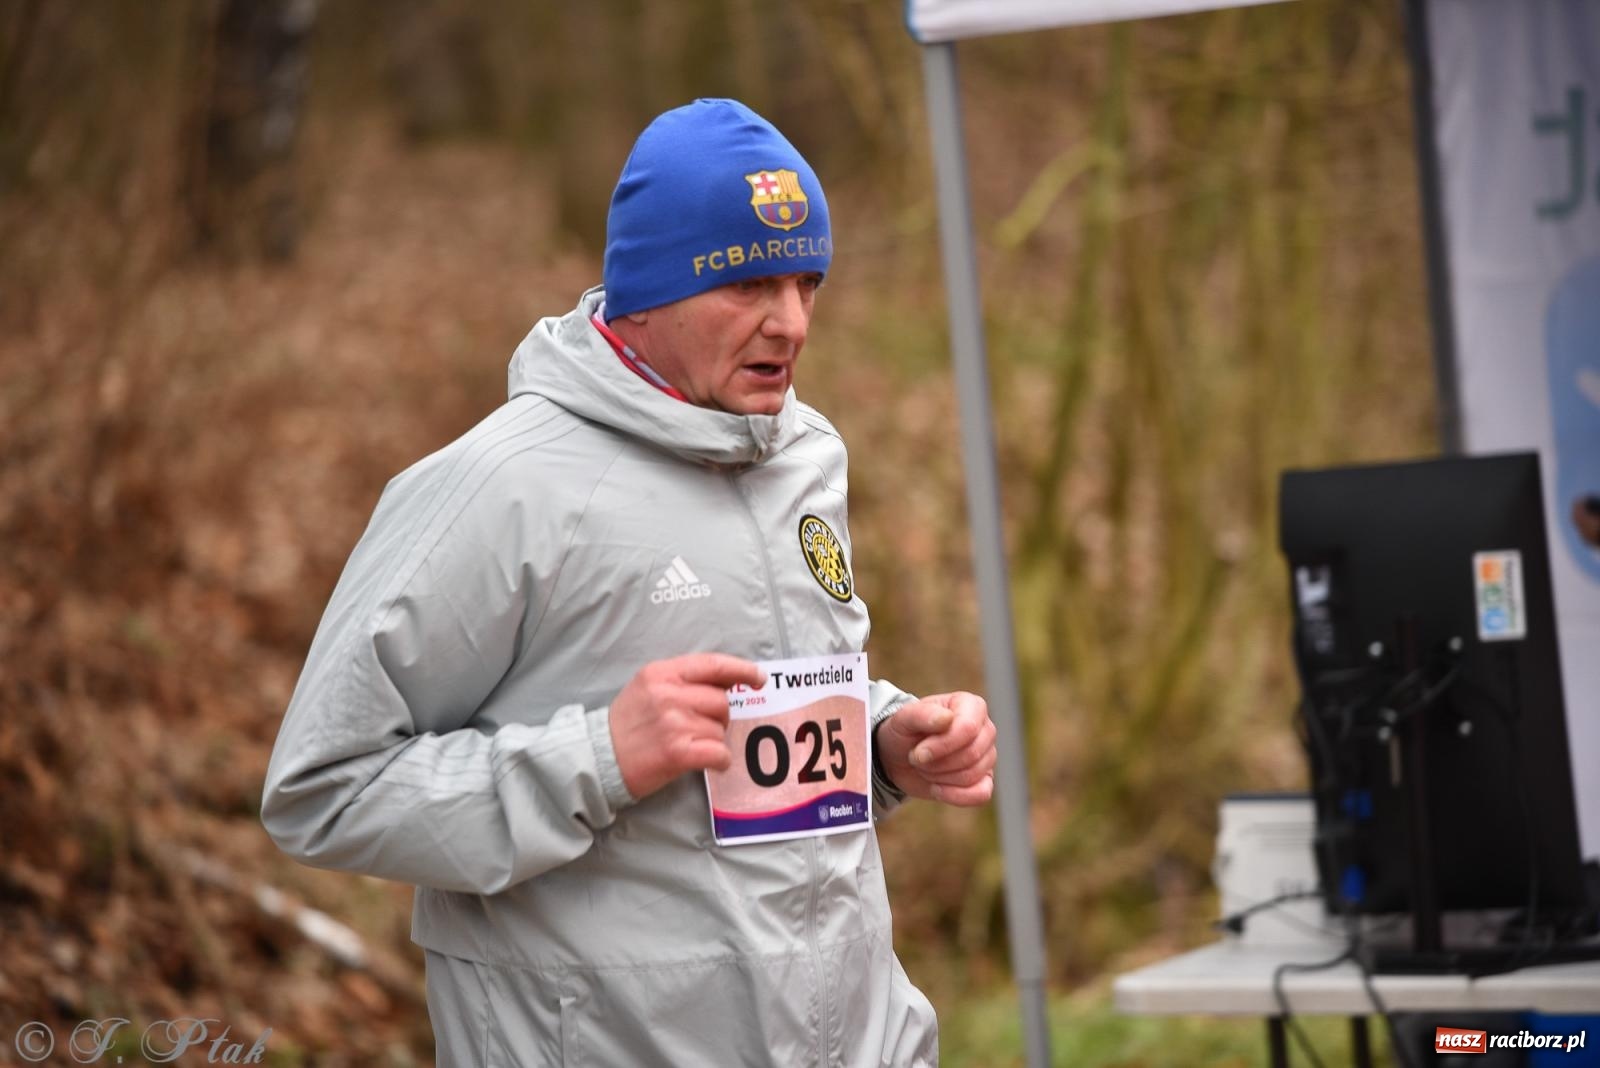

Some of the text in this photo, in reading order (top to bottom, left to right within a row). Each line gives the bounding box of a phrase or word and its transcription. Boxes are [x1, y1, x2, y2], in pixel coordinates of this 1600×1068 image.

[650, 583, 712, 604] adidas
[771, 665, 853, 690] Twardziela
[728, 697, 767, 709] uty 2025
[744, 718, 848, 788] 025
